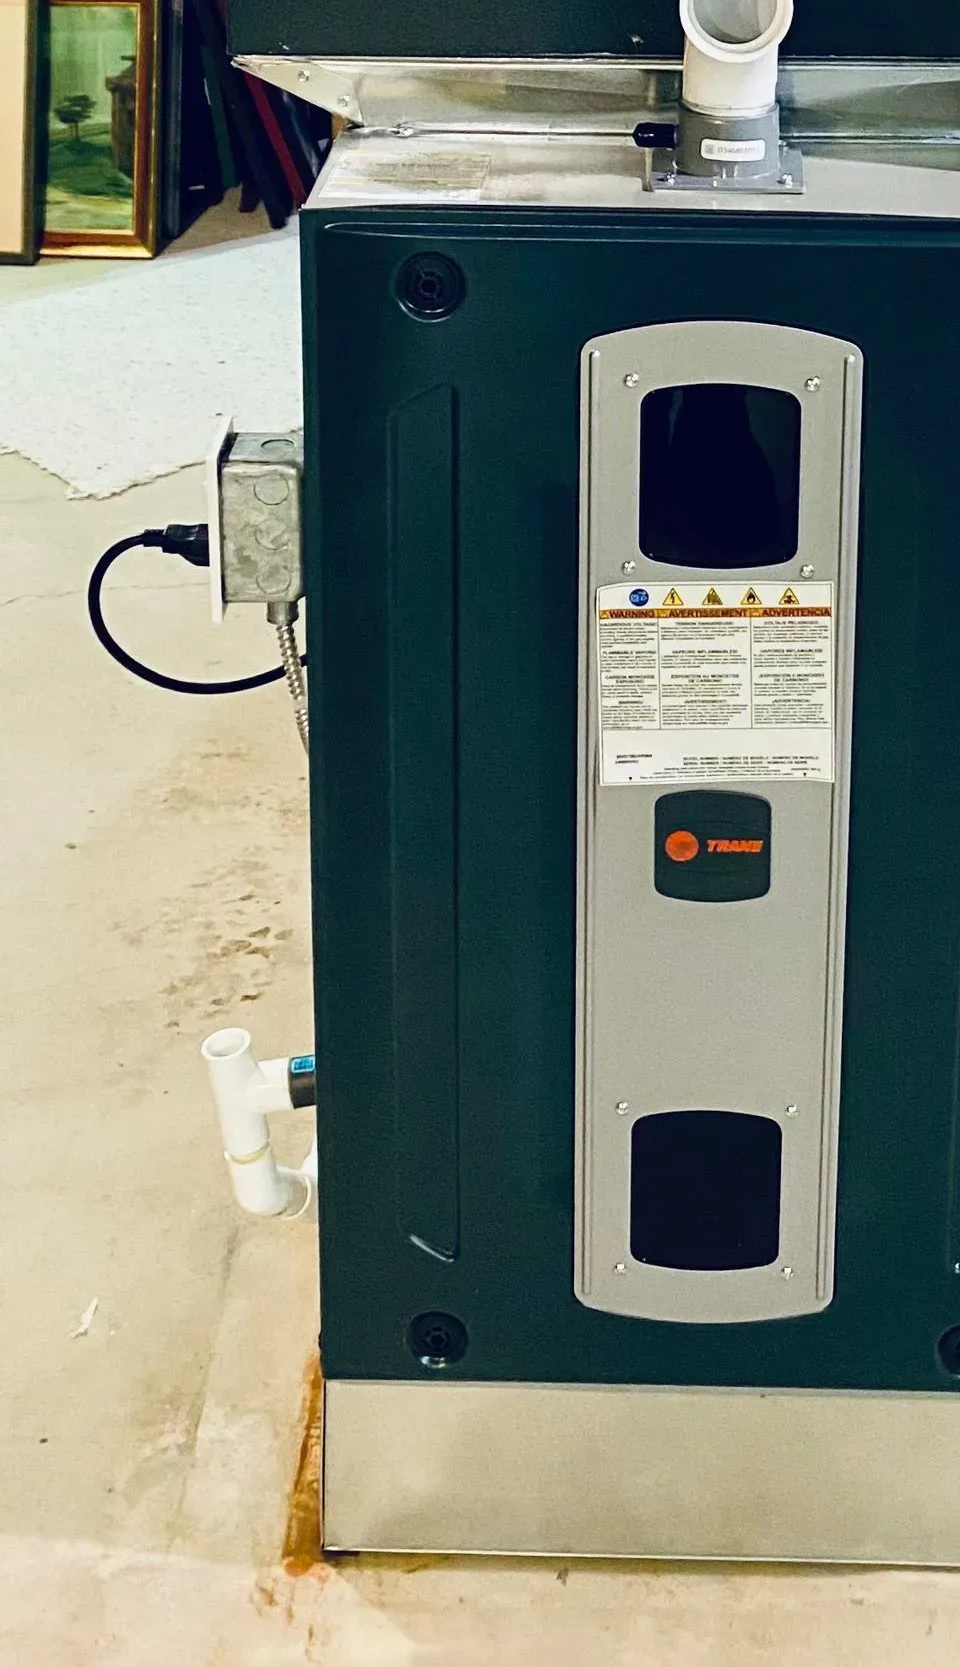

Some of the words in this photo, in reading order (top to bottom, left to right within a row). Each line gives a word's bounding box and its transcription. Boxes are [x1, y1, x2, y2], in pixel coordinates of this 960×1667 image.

[609, 609, 656, 618] WARNING
[669, 609, 747, 618] AVERTISSEMENT
[762, 608, 831, 617] ADVERTENCIA
[707, 839, 764, 853] TRANE
